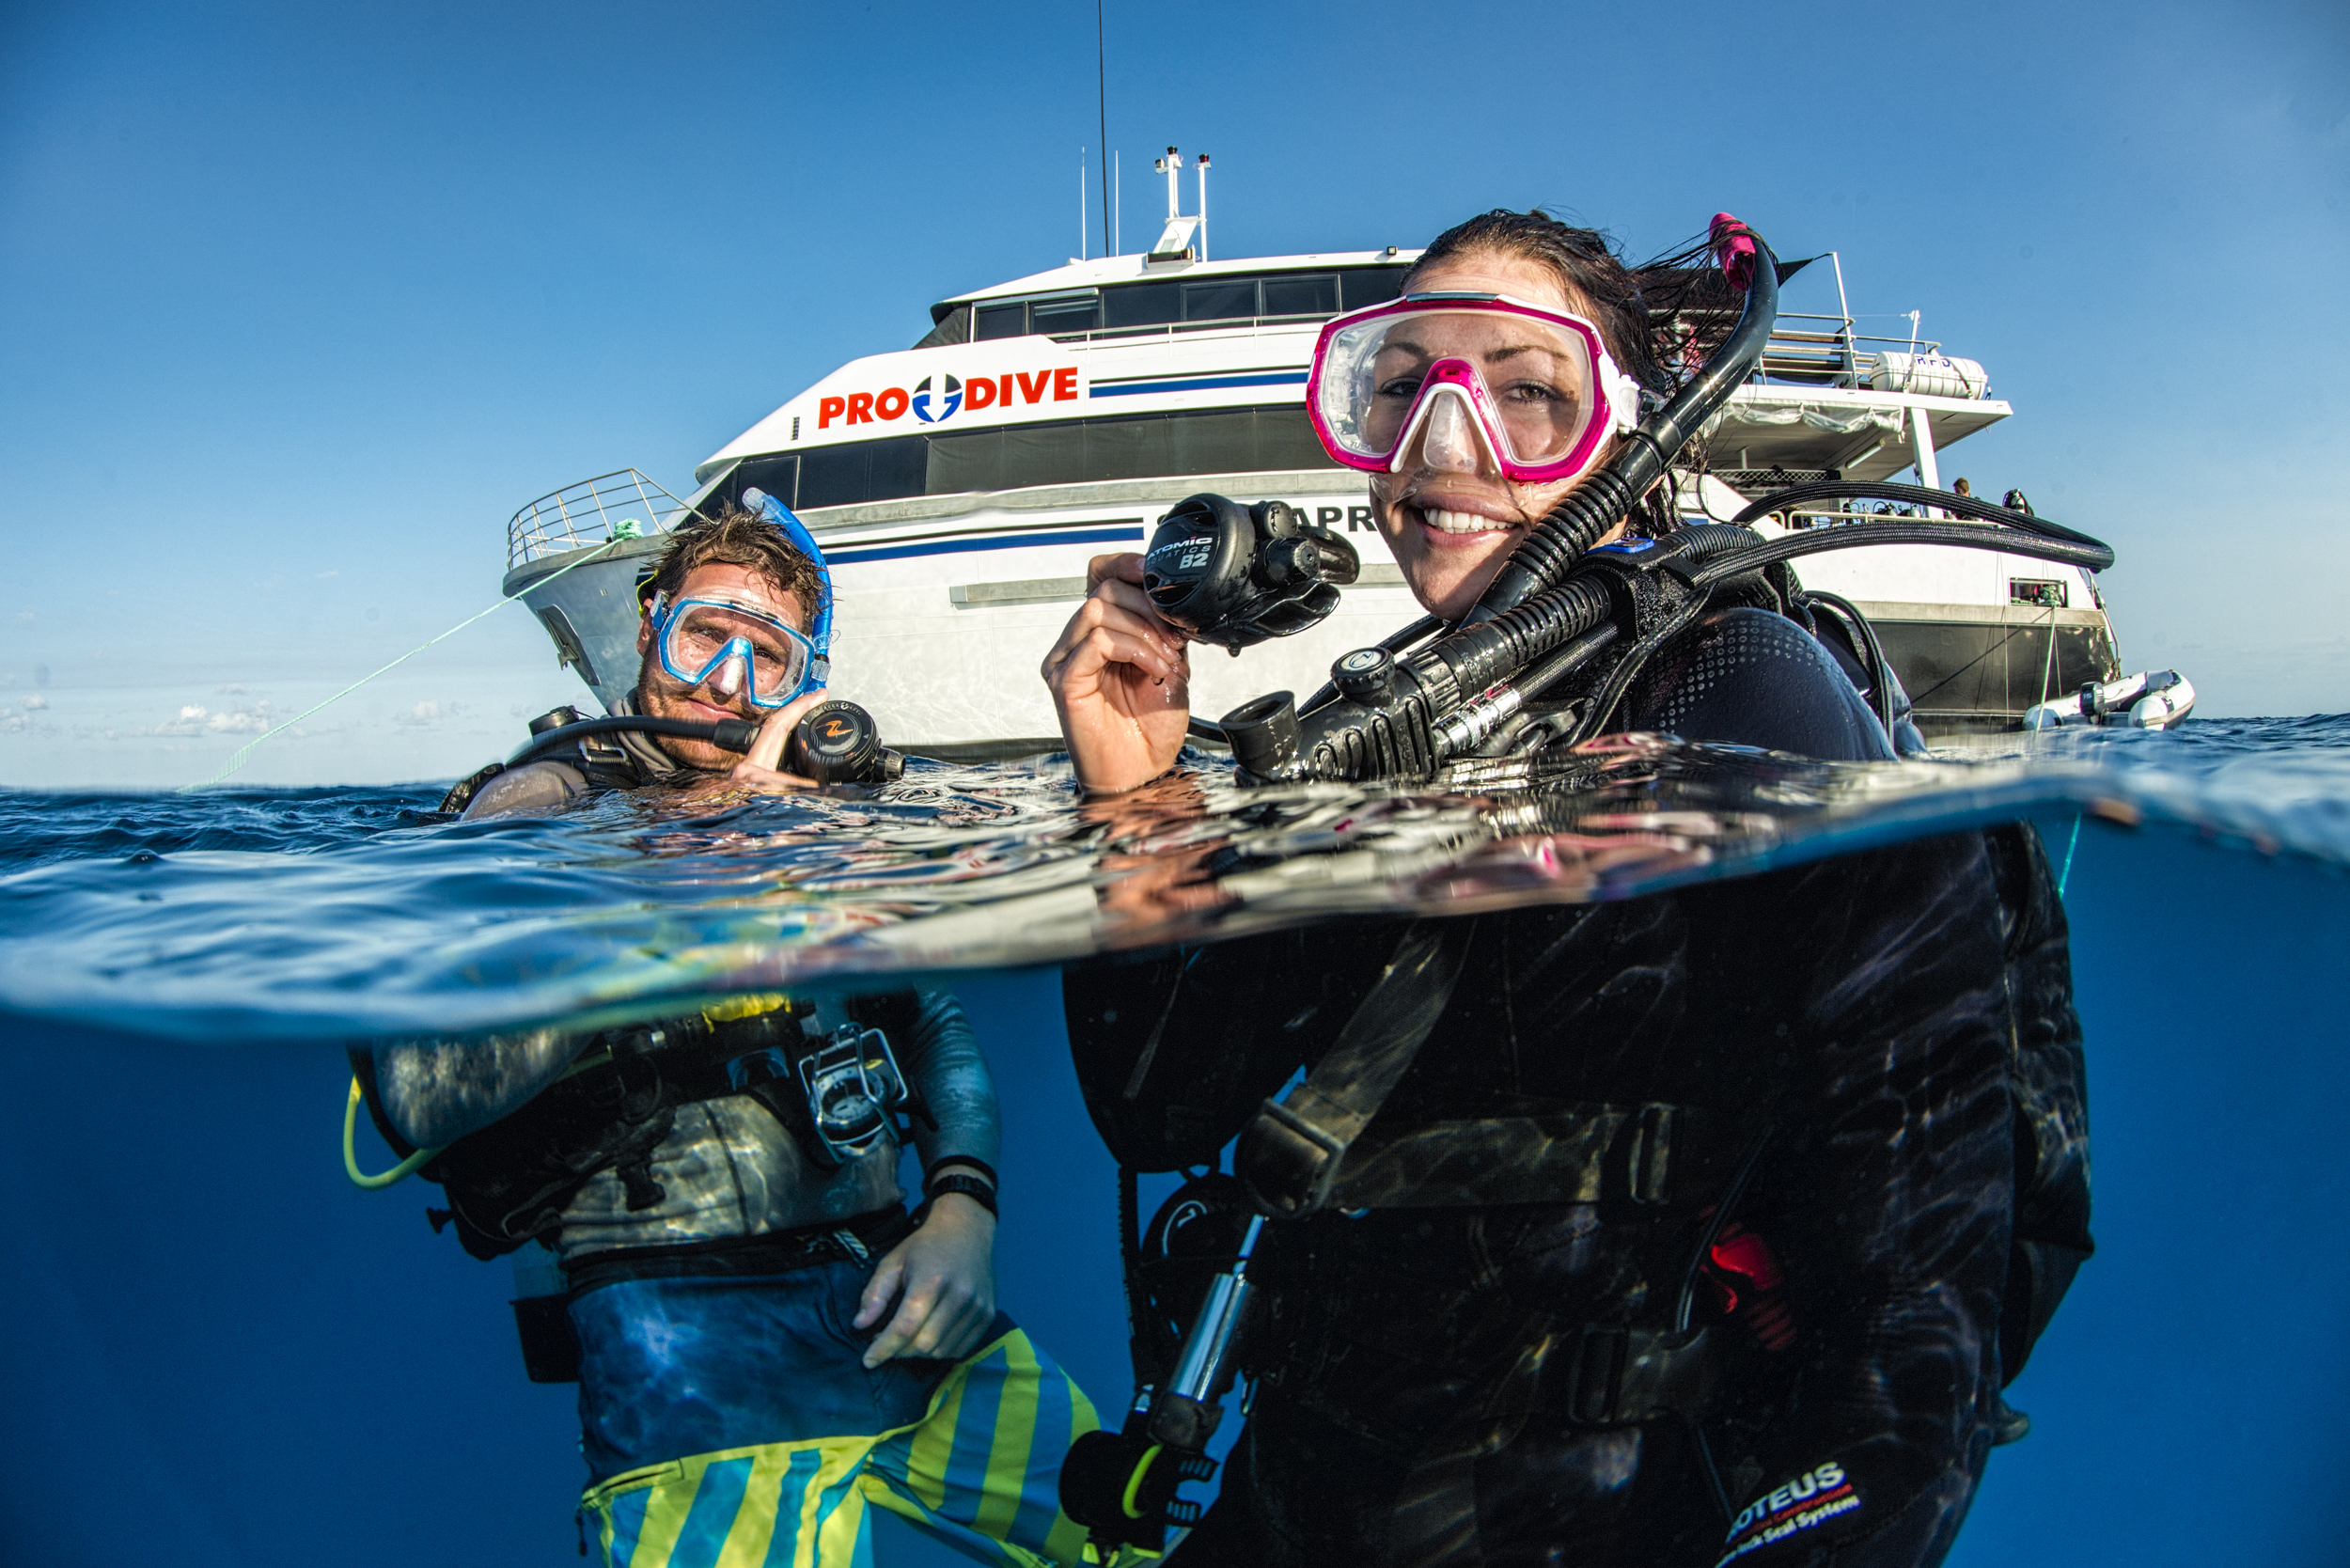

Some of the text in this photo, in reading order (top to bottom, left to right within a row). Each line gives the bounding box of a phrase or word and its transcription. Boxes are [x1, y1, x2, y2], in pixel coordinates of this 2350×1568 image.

[818, 366, 1078, 430] PRO DIVE
[1179, 552, 1209, 570] B2
